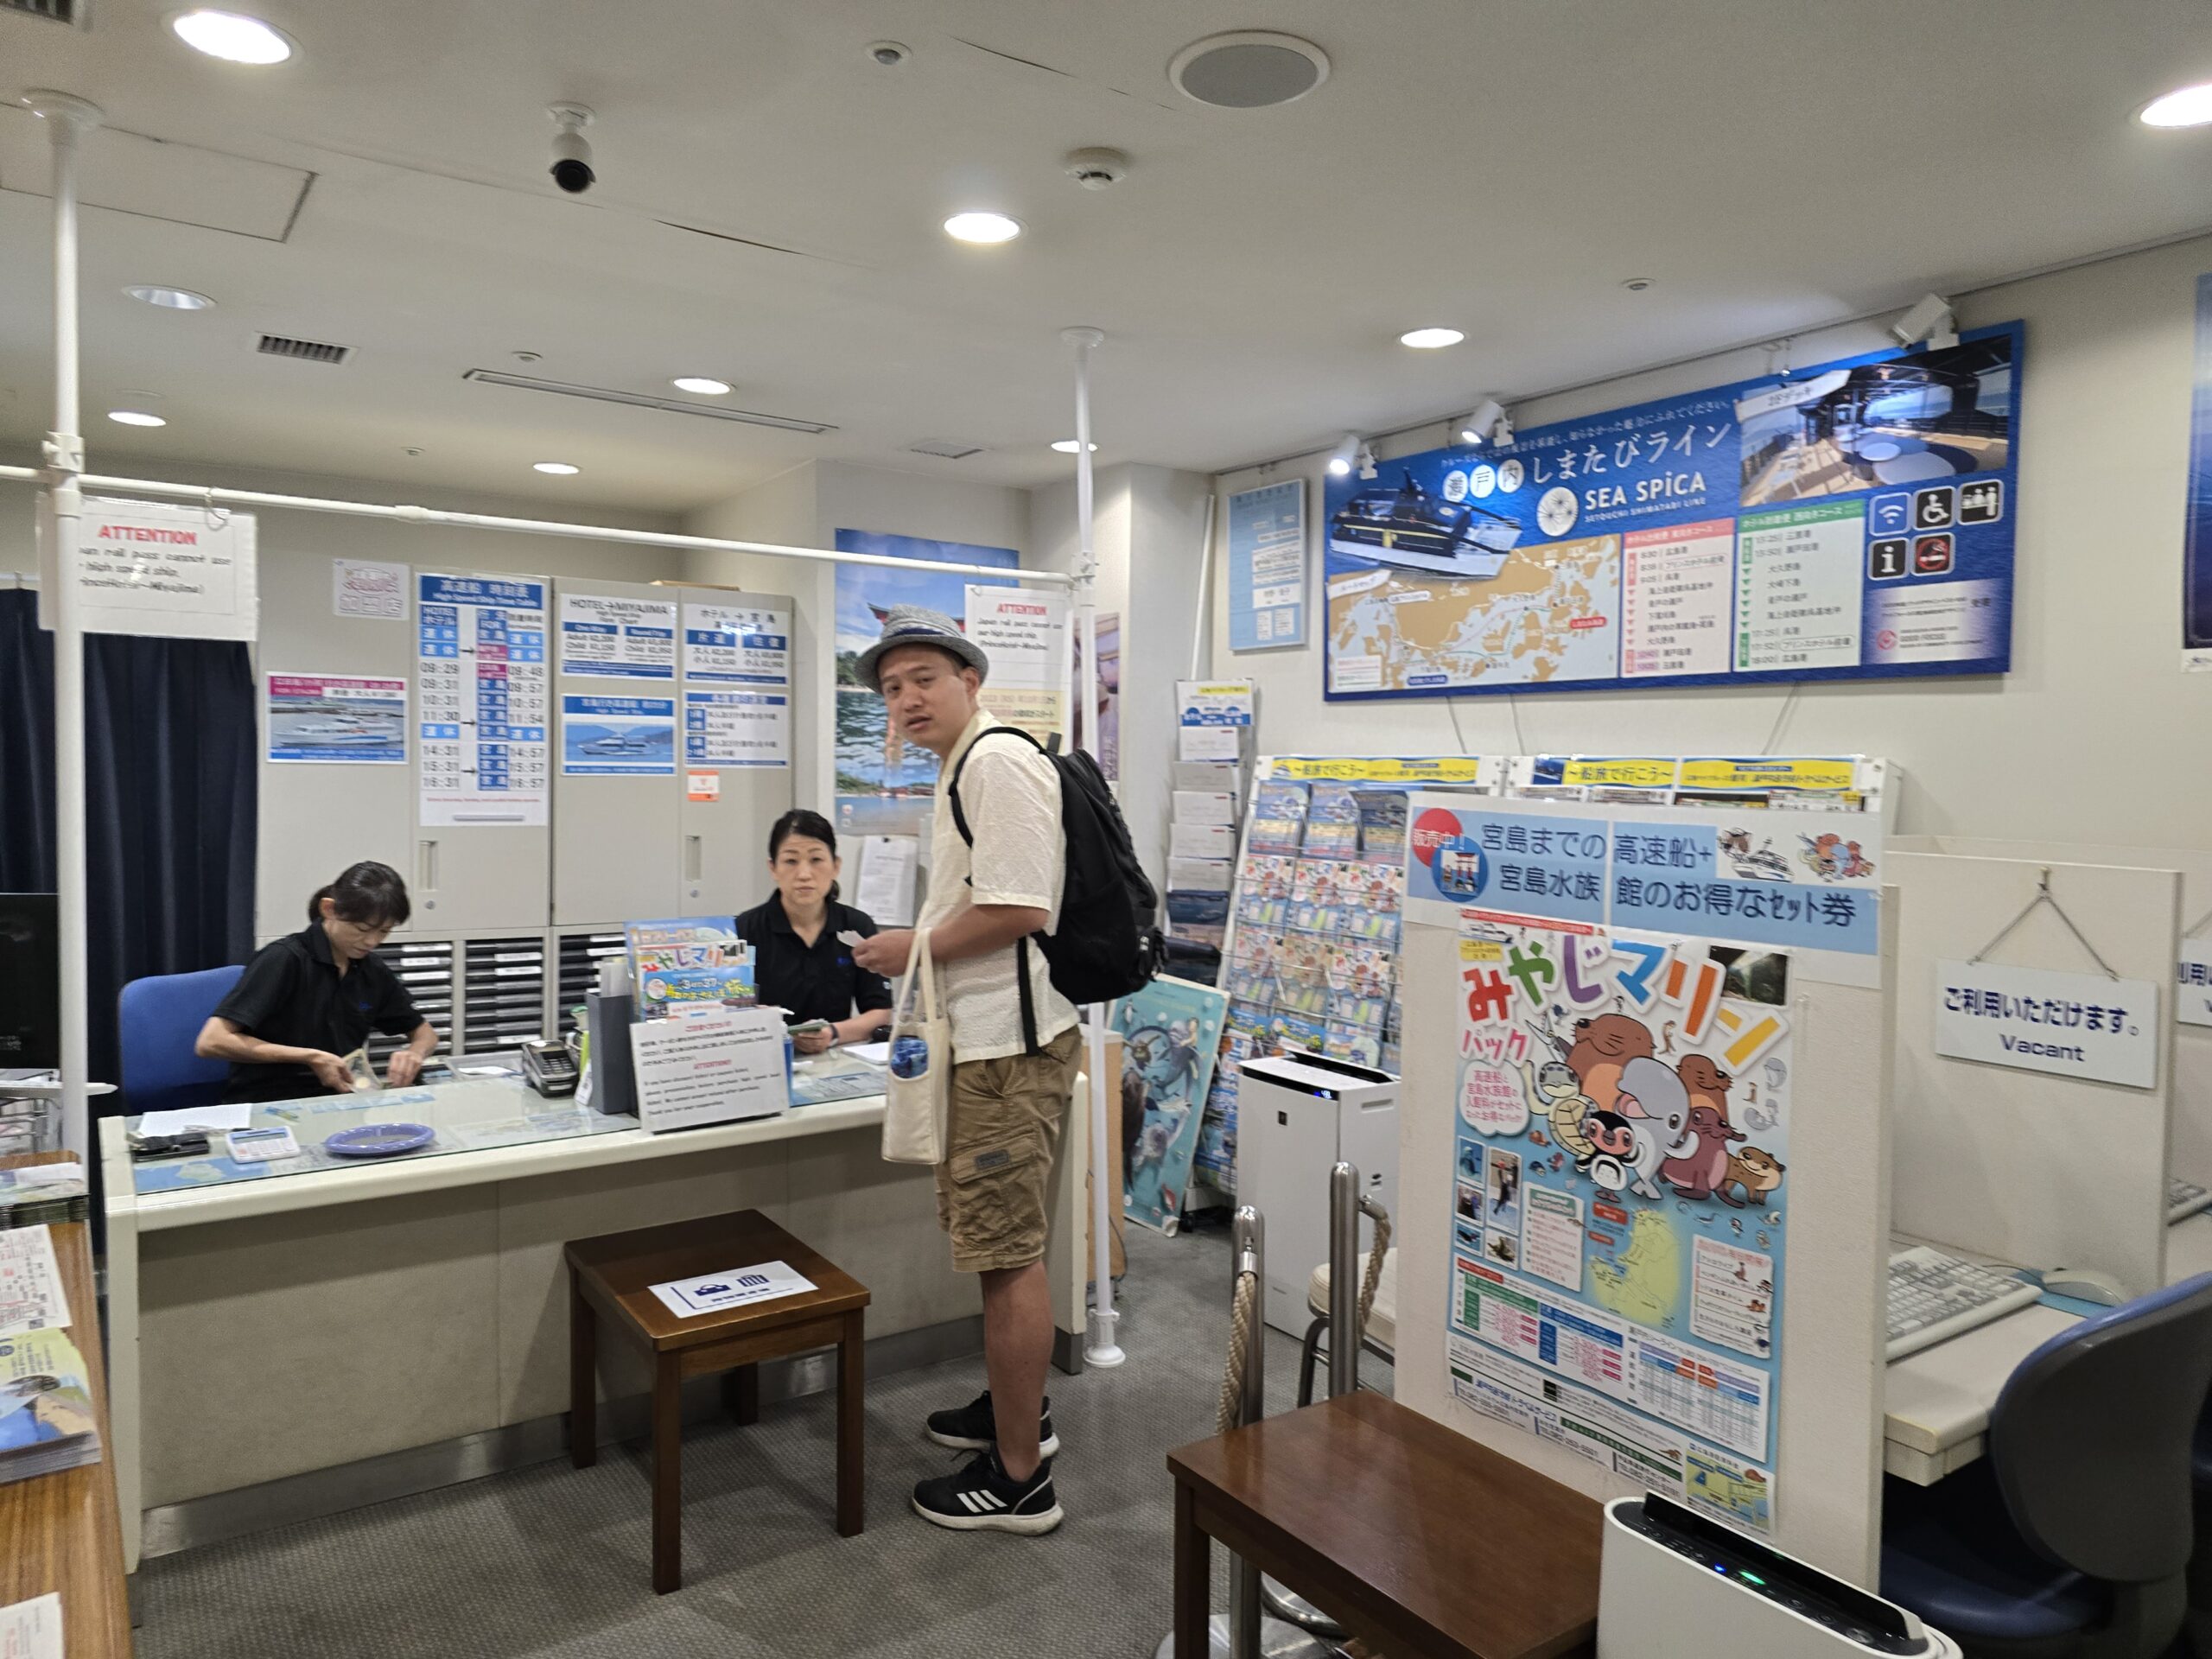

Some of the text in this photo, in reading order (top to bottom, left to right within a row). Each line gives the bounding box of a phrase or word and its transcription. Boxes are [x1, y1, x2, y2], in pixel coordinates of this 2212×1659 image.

[1533, 423, 1733, 486] しまたびライン
[1584, 485, 1627, 511] SEA
[98, 524, 198, 546] ATTENTION
[996, 603, 1048, 616] ATTENTION
[1462, 934, 1782, 1068] みやじマリン
[1944, 985, 2140, 1037] ご利用いただけます。
[1462, 1027, 1529, 1062] パック
[1999, 1033, 2086, 1062] Vacant
